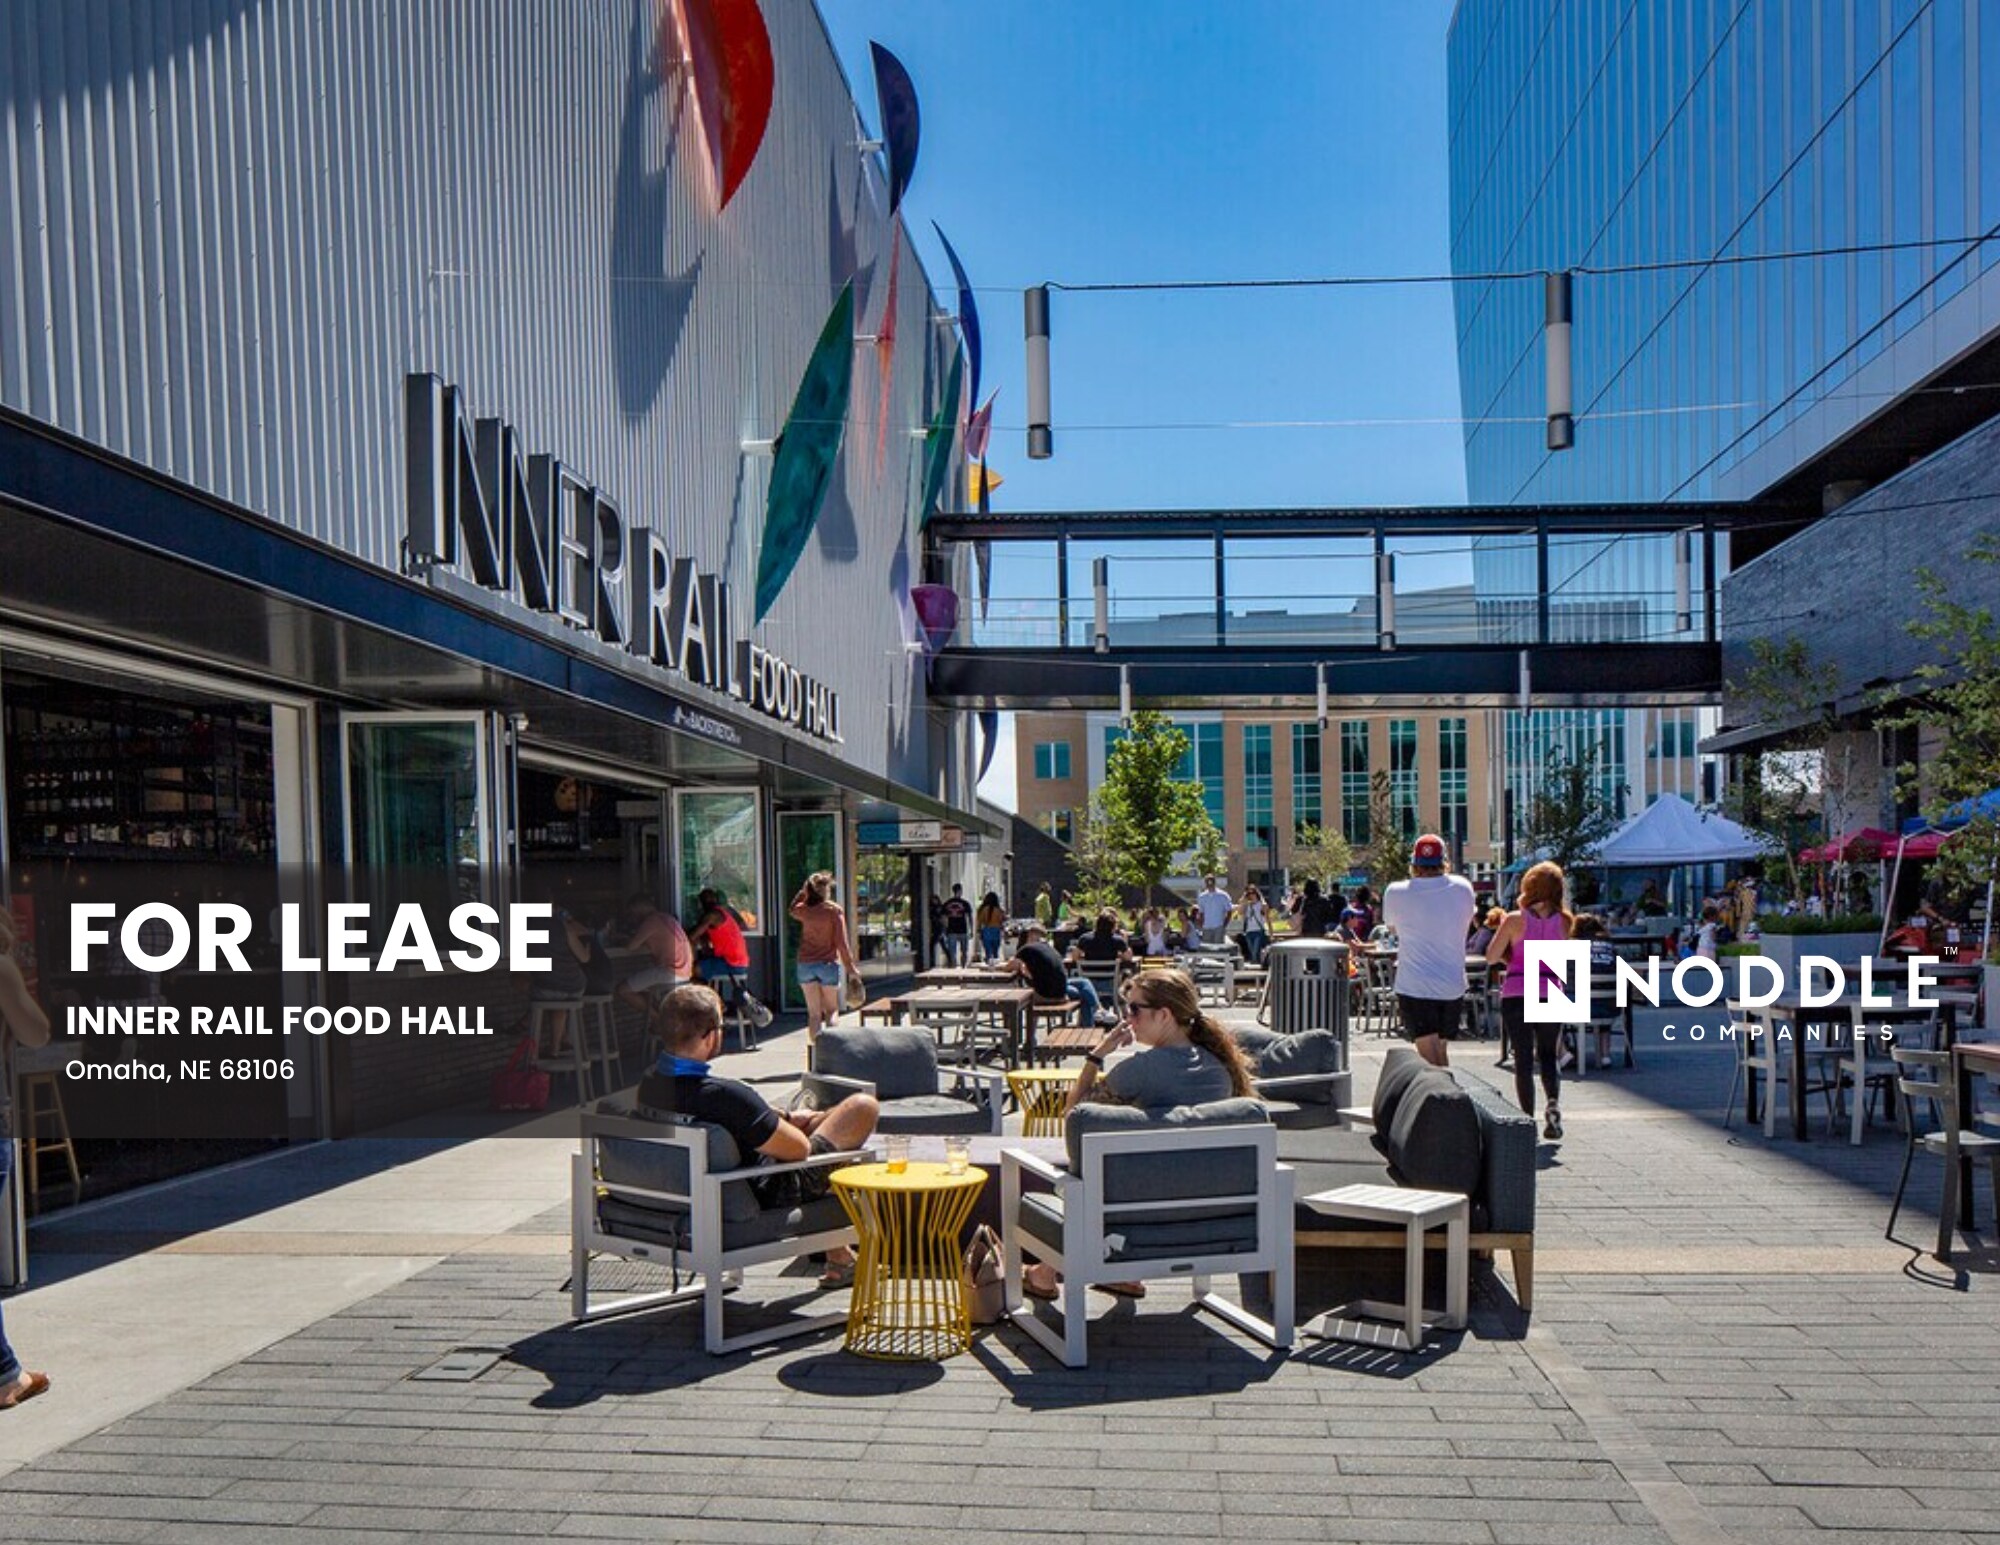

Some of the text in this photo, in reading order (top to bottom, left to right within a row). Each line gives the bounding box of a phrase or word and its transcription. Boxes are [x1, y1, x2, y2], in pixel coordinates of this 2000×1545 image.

[408, 372, 742, 700] INNER RAIL
[742, 642, 845, 743] FOOD HALL
